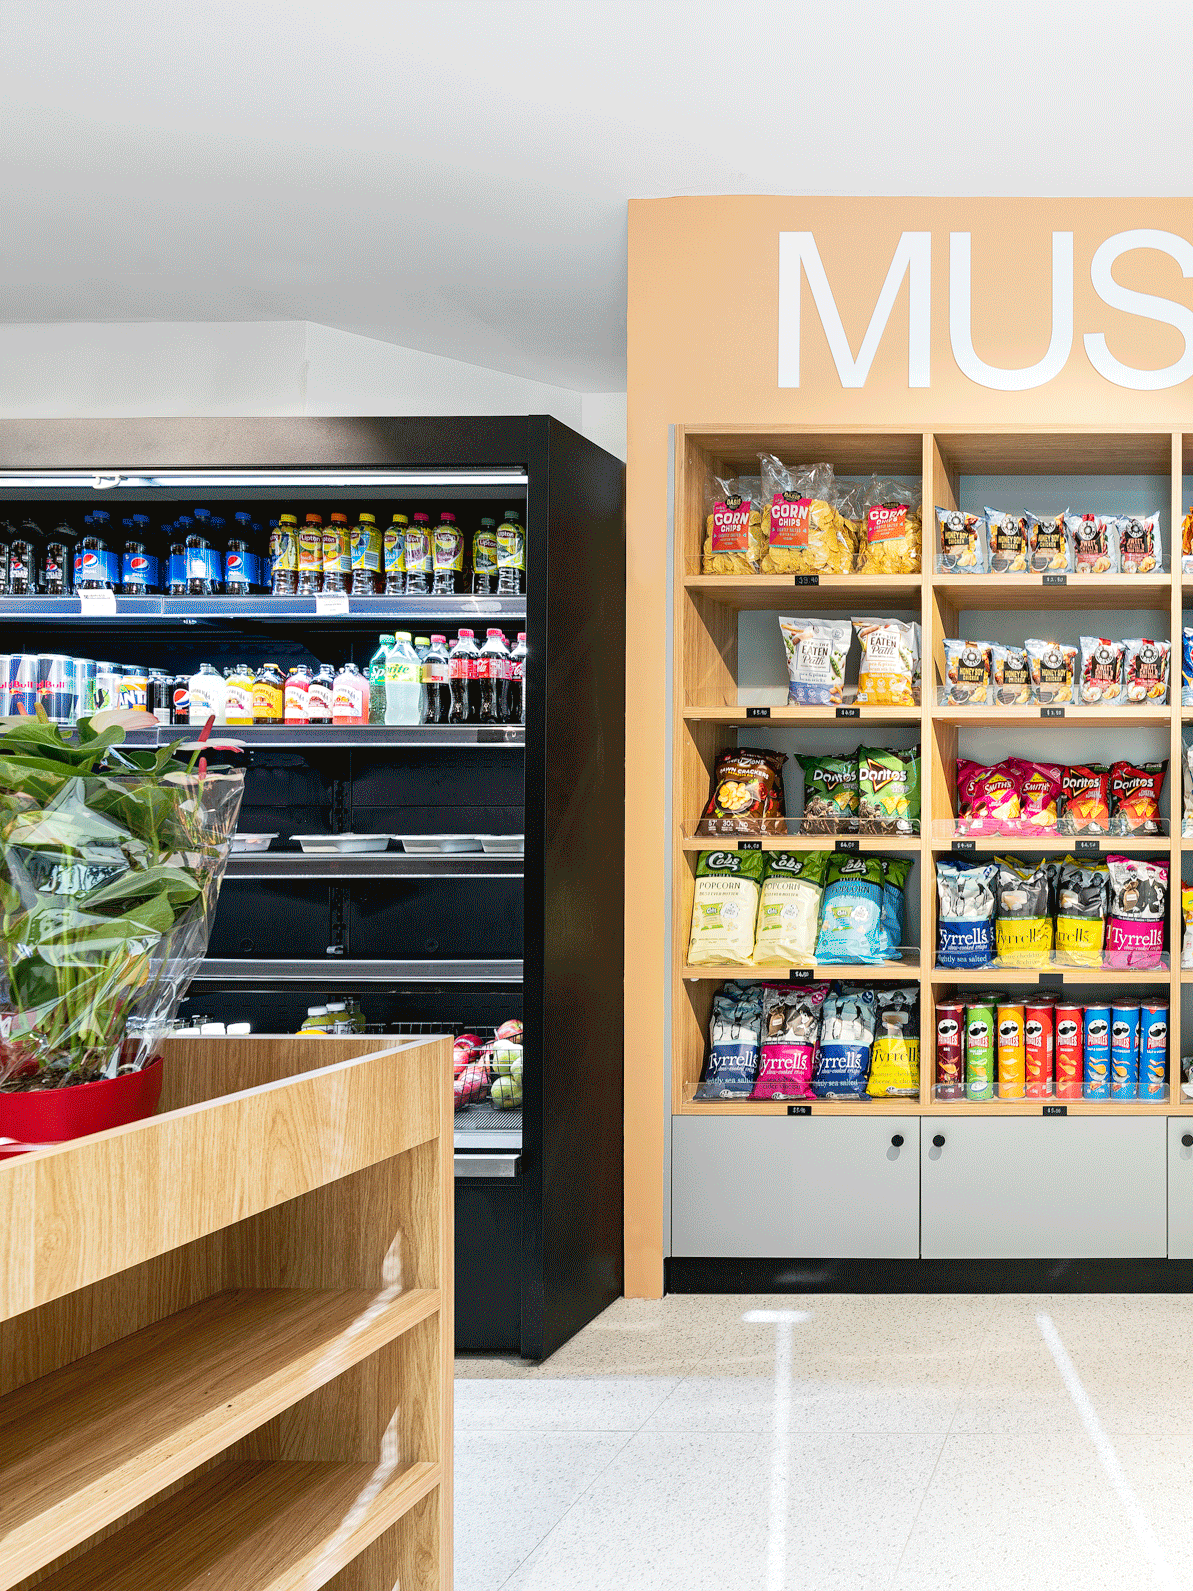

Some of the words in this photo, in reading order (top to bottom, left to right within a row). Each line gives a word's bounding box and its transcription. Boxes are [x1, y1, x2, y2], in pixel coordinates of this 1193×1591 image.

[771, 504, 809, 519] CORN
[869, 508, 908, 521] CORN
[714, 512, 749, 525] CORN
[778, 518, 801, 527] CHIPS
[720, 524, 741, 533] CHIPS
[301, 535, 321, 543] Lipton
[478, 540, 497, 548] Lipton
[871, 637, 896, 647] EATEN
[801, 645, 828, 656] EATEN
[871, 646, 894, 656] Path
[803, 655, 825, 665] Path
[737, 768, 769, 779] CRACKERS
[813, 769, 856, 782] Doritos
[859, 768, 907, 782] Doritos
[1063, 776, 1100, 789] Doritos
[1113, 778, 1154, 790] Doritos
[708, 852, 741, 871] Cobs
[699, 881, 741, 890] POPCORN
[764, 881, 800, 891] POPCORN
[831, 885, 870, 894] POPCORN
[939, 927, 989, 951] Tyrrell's
[1112, 927, 1162, 950] Tyrrell's
[969, 955, 987, 963] salted
[938, 1036, 958, 1046] PRINGLES
[968, 1037, 989, 1047] PRINGLES
[999, 1036, 1019, 1046] PRINGLES
[1057, 1036, 1077, 1046] PRINGLES
[1088, 1035, 1108, 1045] PRINGLES
[1147, 1037, 1167, 1047] PRINGLES
[709, 1050, 758, 1074] Tyrrell's
[817, 1051, 862, 1075] yrrell's
